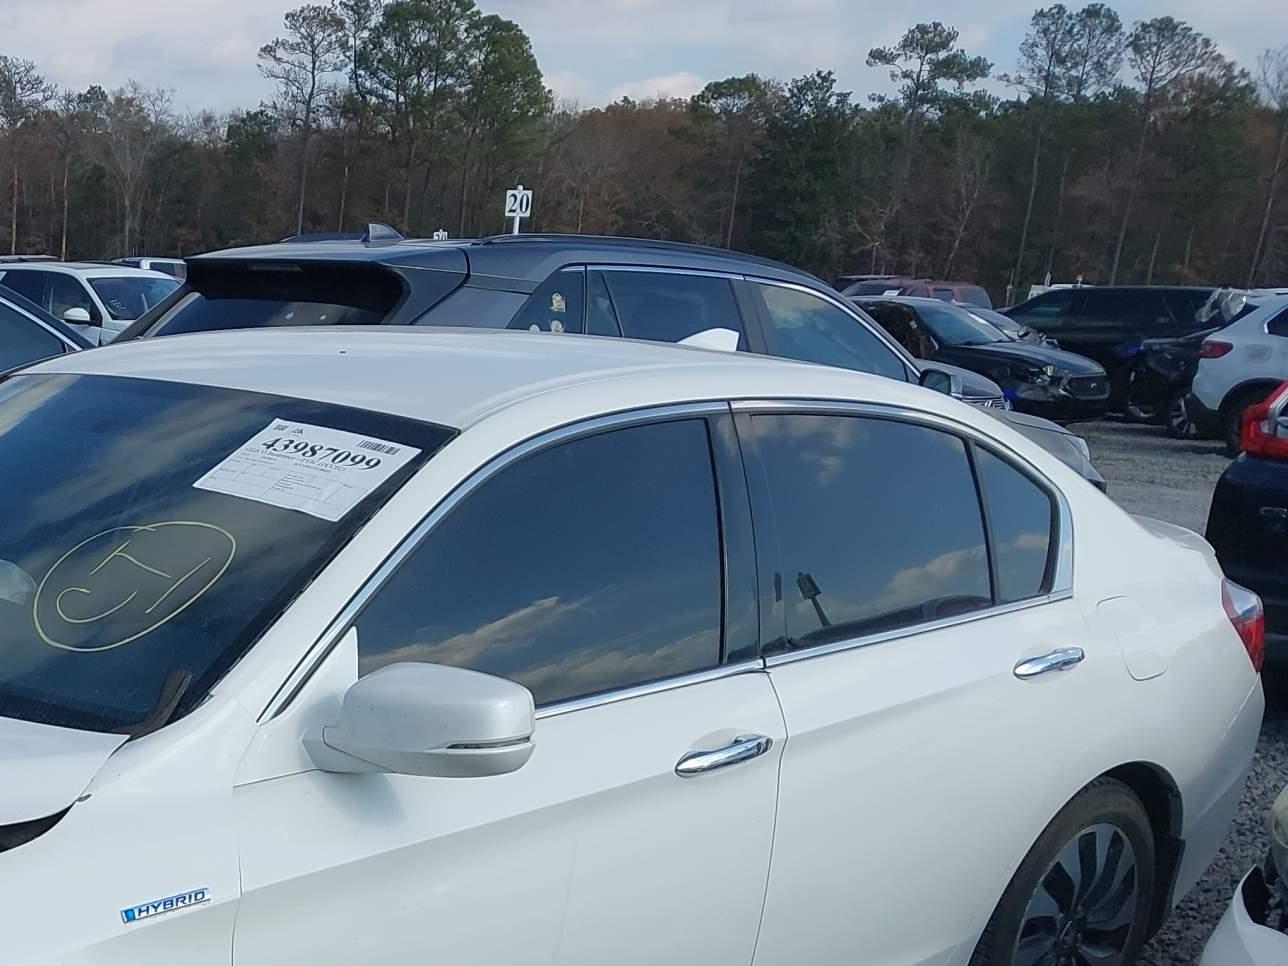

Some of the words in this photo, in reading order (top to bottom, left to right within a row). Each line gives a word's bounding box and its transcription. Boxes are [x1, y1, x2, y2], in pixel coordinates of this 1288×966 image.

[507, 193, 530, 214] 20
[262, 437, 382, 471] 43987099
[137, 891, 205, 917] HYBRID
